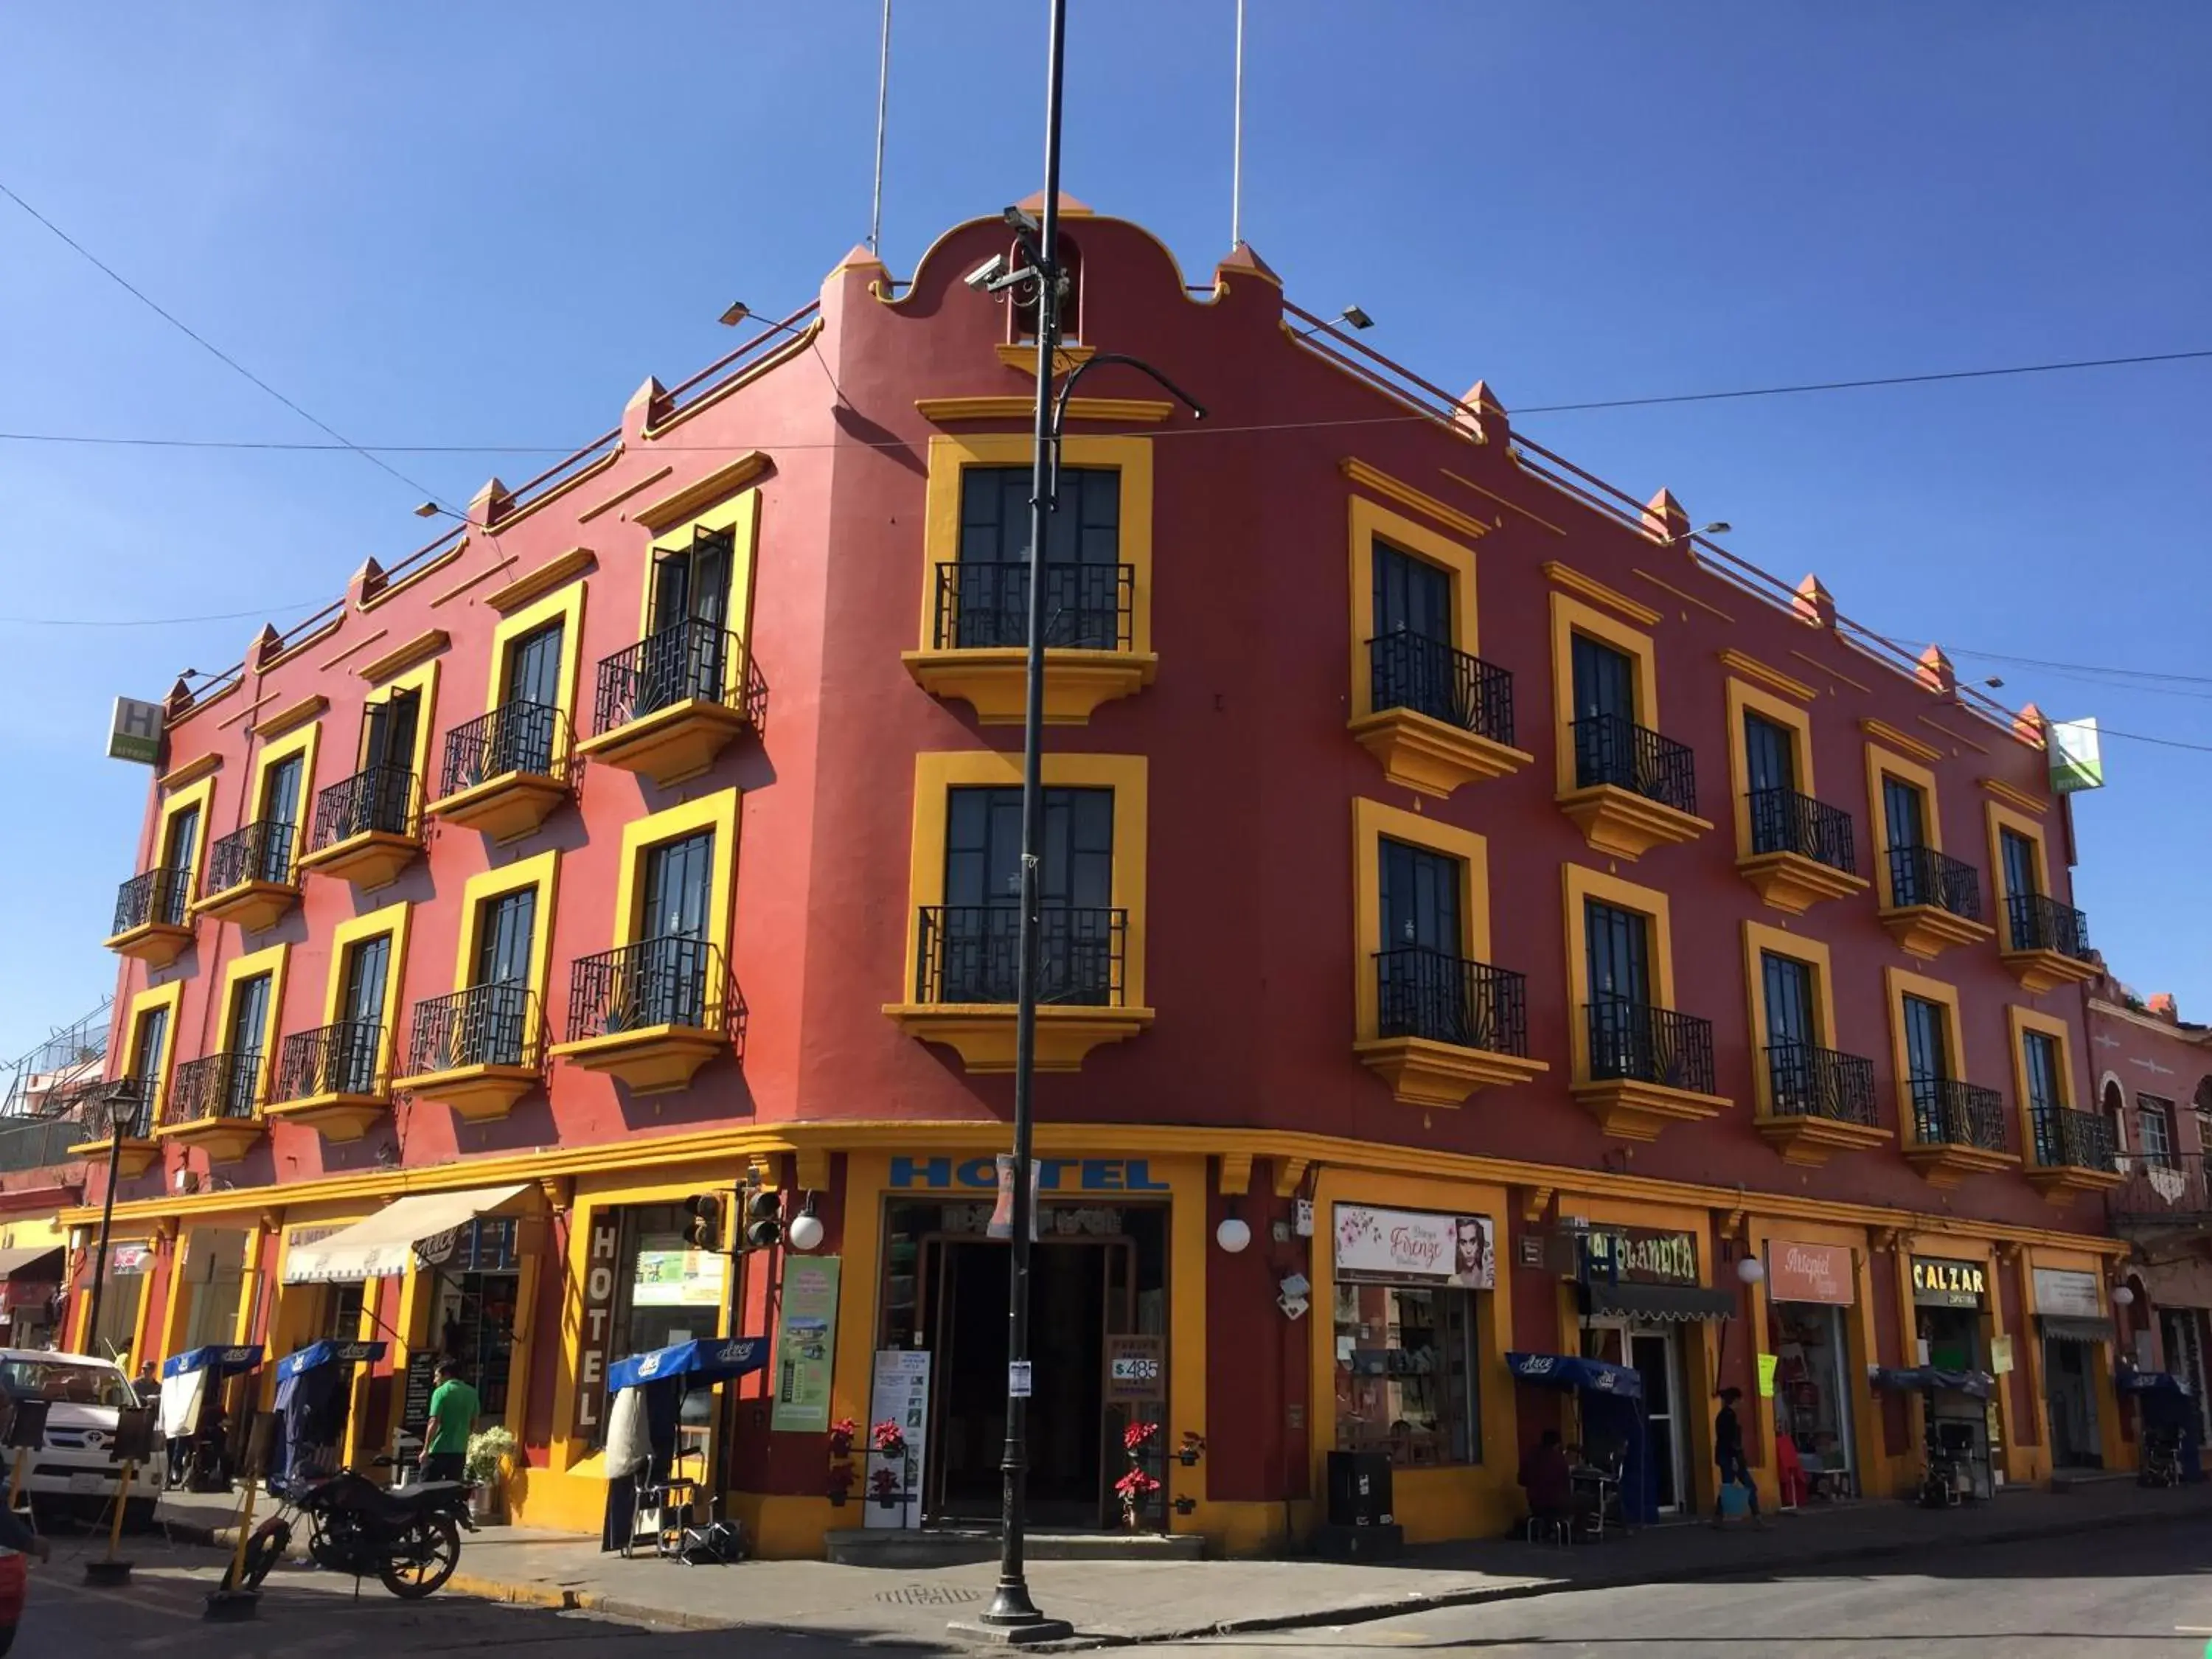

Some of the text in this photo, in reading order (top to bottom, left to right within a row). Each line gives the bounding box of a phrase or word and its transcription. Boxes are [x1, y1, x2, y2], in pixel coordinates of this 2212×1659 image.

[124, 703, 156, 737] H
[889, 1156, 1170, 1190] HOTEL
[1913, 1264, 1984, 1292] CALZAR
[580, 1226, 616, 1425] HOTEL
